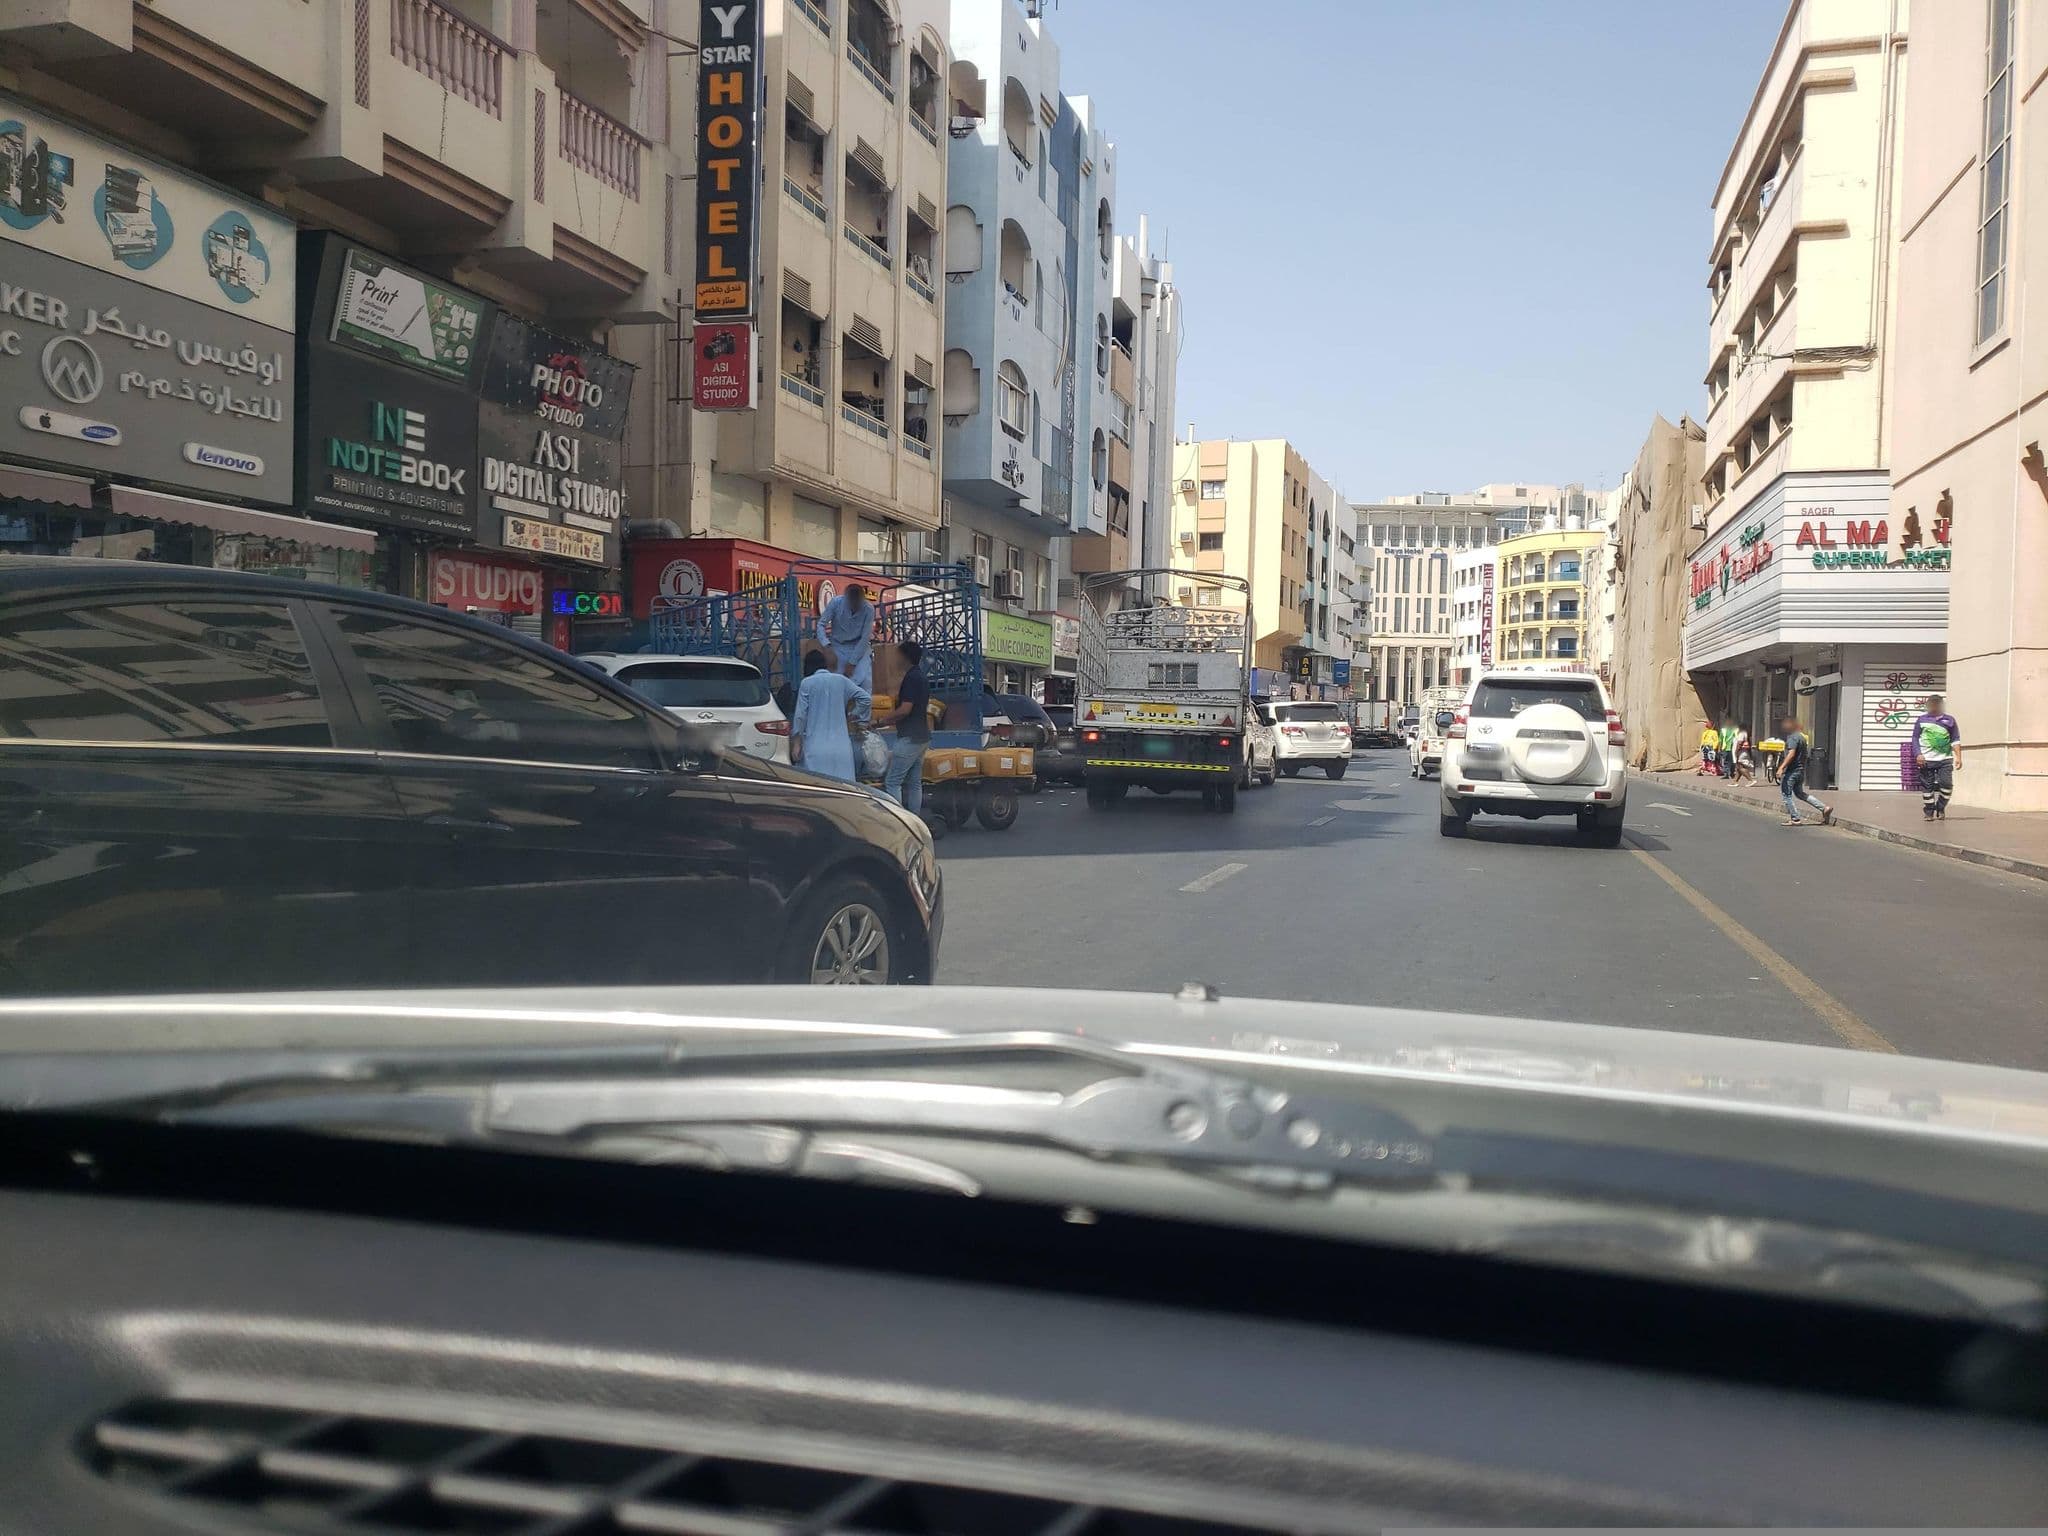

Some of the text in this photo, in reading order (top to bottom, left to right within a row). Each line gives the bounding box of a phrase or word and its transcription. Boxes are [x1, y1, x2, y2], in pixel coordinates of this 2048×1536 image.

[710, 5, 746, 38] Y
[702, 45, 752, 65] STAR
[707, 71, 744, 278] HOTEL
[361, 278, 400, 306] Print
[702, 375, 739, 386] DIGITAL
[712, 362, 729, 373] ASI
[530, 362, 603, 408] PHOTO
[702, 389, 739, 400] STUDIO
[536, 402, 585, 429] STUDIO
[196, 447, 257, 472] lenovo
[534, 429, 581, 474] ASI
[330, 438, 466, 495] NOTEBOOK
[332, 476, 384, 499] PRINTING
[387, 486, 396, 501] &
[399, 488, 464, 515] ADVERTISING
[484, 457, 558, 506] DIGITAL
[559, 477, 621, 520] STUDIO
[1800, 507, 1835, 516] SAQER
[1795, 521, 1836, 546] AL
[1811, 548, 1952, 568] SUPERMRKET
[436, 558, 538, 605] STUDIO
[1482, 593, 1493, 657] RELAX
[1012, 640, 1045, 660] COMPUTER
